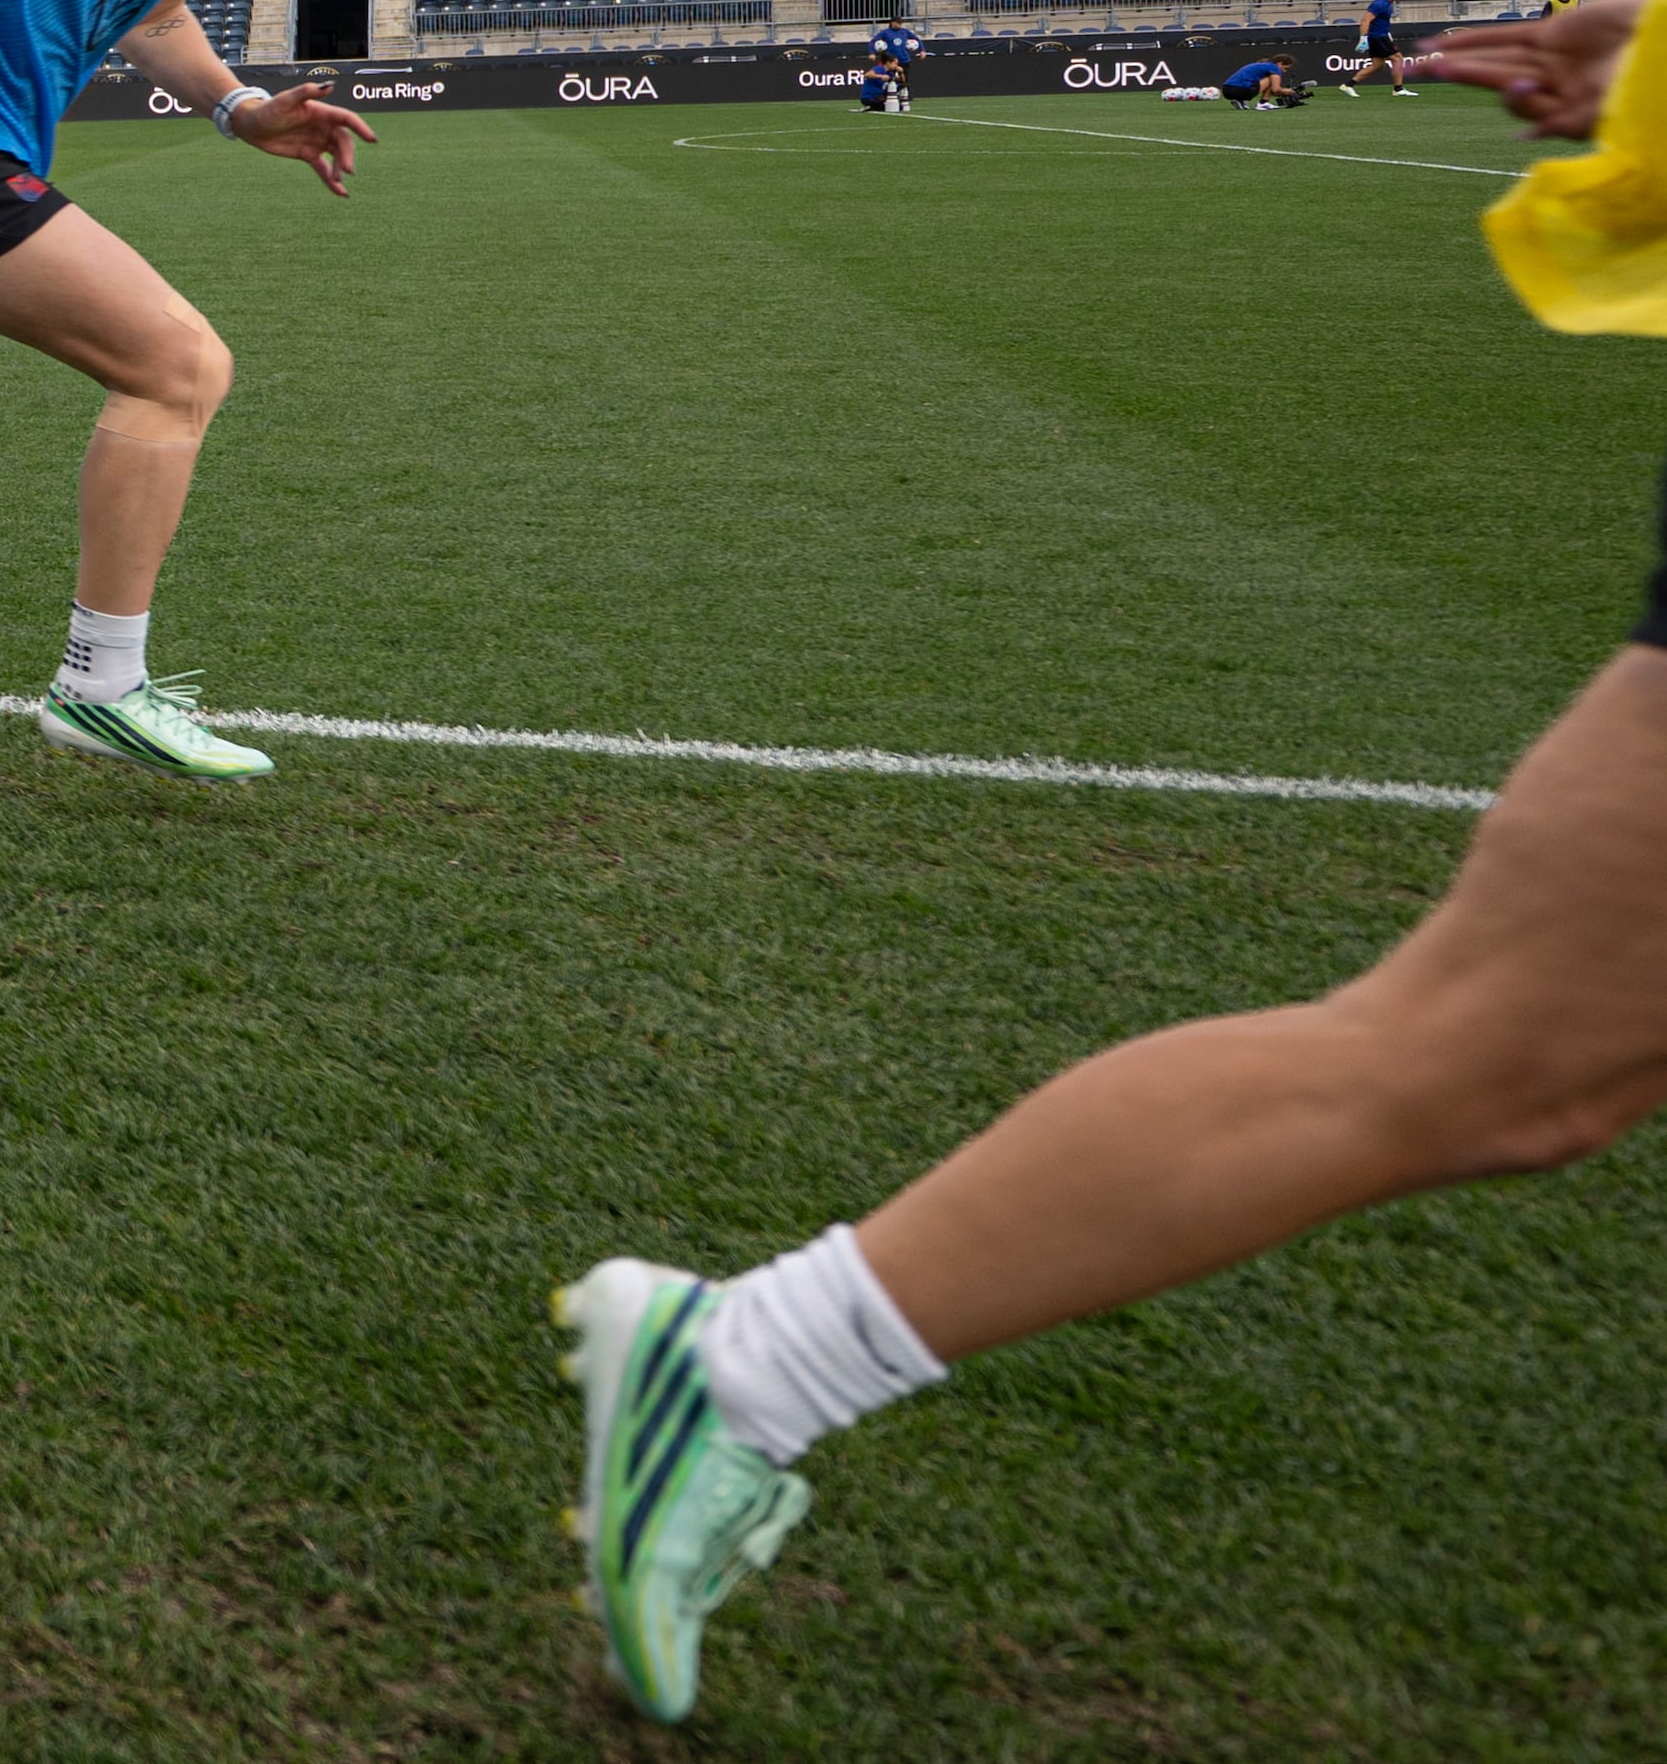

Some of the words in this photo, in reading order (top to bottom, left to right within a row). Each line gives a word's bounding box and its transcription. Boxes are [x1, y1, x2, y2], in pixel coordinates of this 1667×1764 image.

[798, 70, 846, 87] Oura
[847, 69, 864, 87] Ri
[1063, 57, 1177, 89] ŌURA
[351, 83, 392, 101] Oura
[393, 82, 433, 104] Ring
[558, 73, 659, 102] ŌURA
